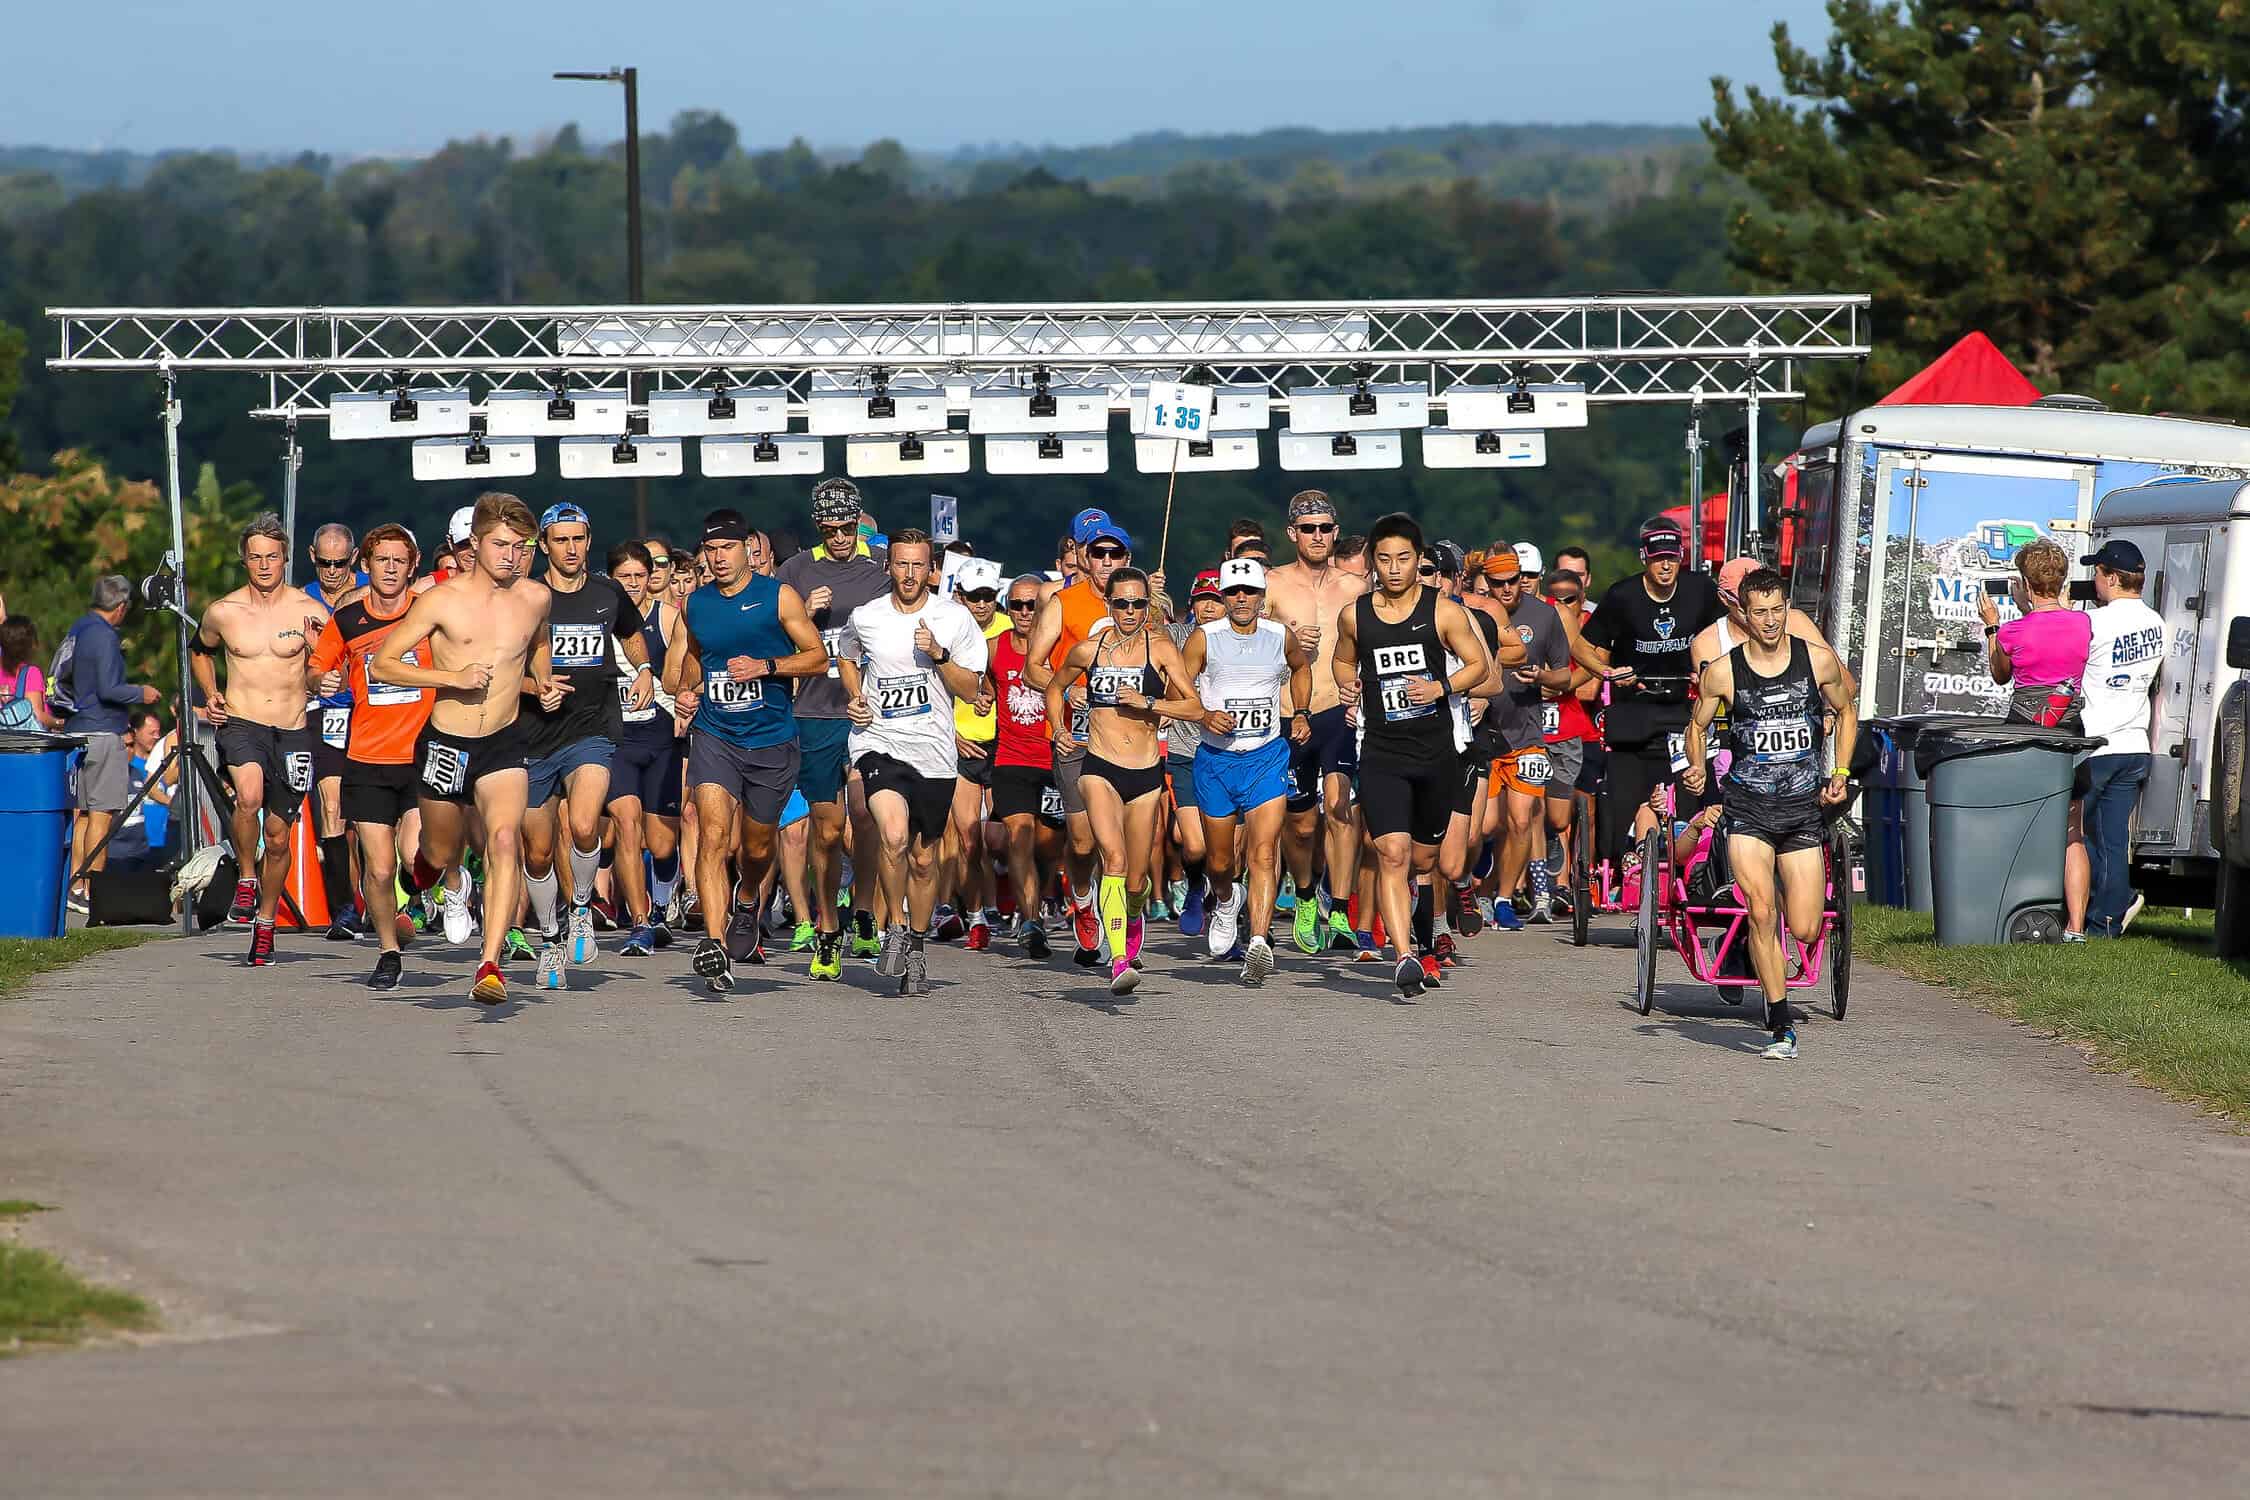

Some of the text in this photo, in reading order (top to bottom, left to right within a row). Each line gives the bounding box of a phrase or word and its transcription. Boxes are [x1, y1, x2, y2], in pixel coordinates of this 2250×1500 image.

[554, 636, 601, 656] 2317
[2113, 632, 2138, 650] ARE
[2140, 626, 2162, 642] YOU
[1380, 650, 1420, 668] BRC
[2112, 640, 2163, 664] MIGHTY?
[712, 680, 760, 702] 1629
[880, 685, 929, 709] 2270
[1757, 728, 1809, 752] 2056
[1520, 761, 1552, 778] 1692
